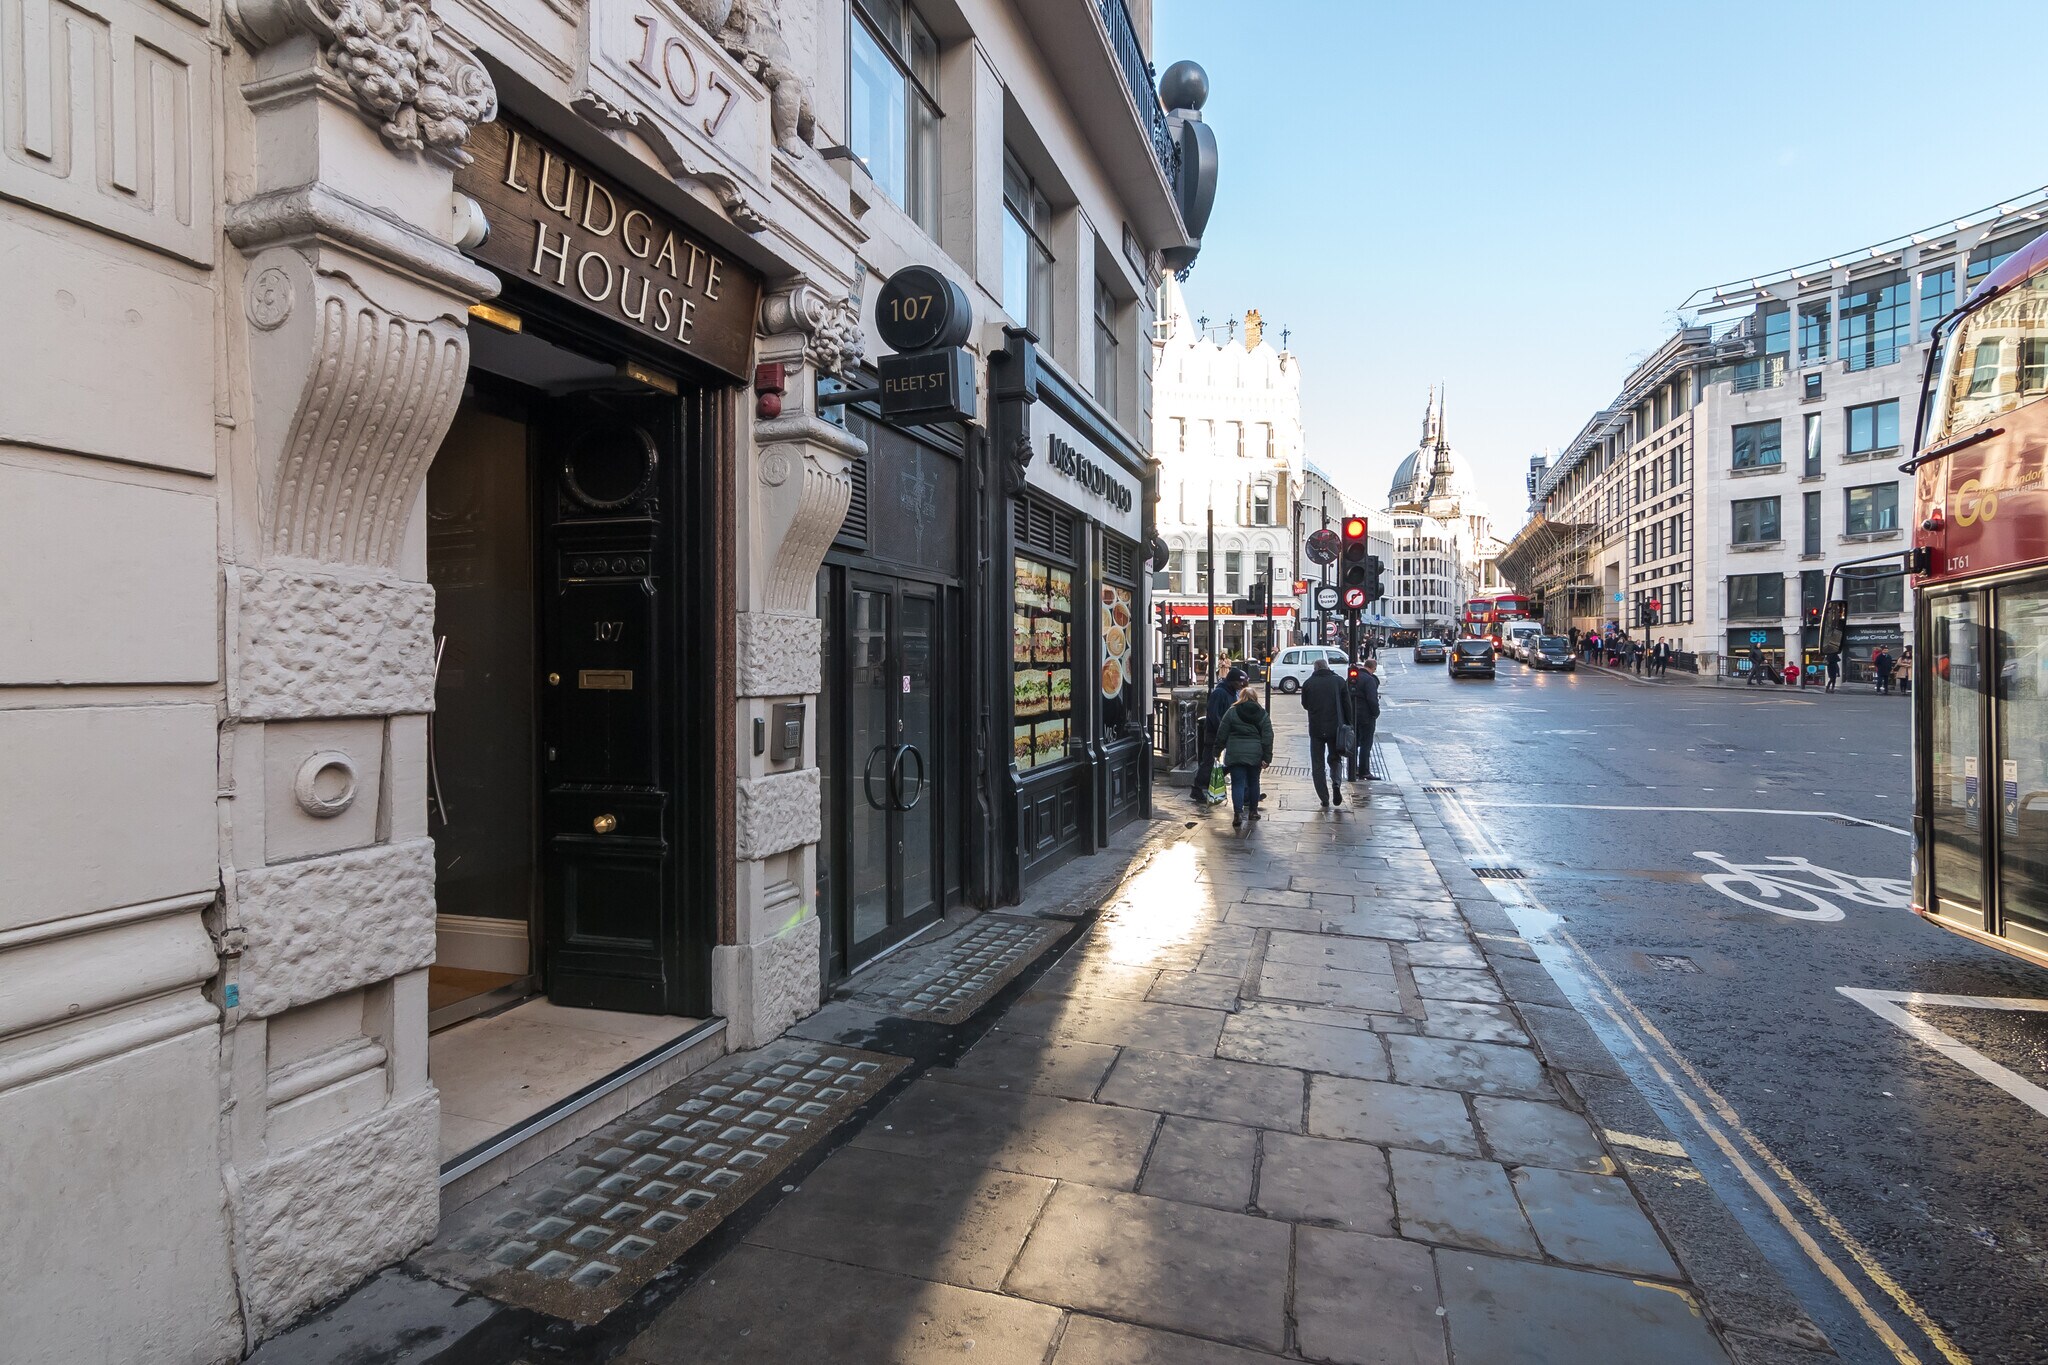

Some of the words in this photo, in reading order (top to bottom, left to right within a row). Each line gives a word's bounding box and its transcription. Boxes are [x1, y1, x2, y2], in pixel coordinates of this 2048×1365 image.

[628, 14, 741, 138] 107
[502, 128, 723, 301] LUDGATE
[530, 218, 697, 345] HOUSE
[890, 295, 933, 322] 107
[885, 375, 926, 393] FLEET
[928, 372, 946, 388] ST
[1955, 479, 1998, 527] Go
[1947, 555, 1969, 571] LT61
[1215, 606, 1233, 615] EON
[593, 621, 624, 642] 107
[1846, 634, 1869, 642] Ludgate
